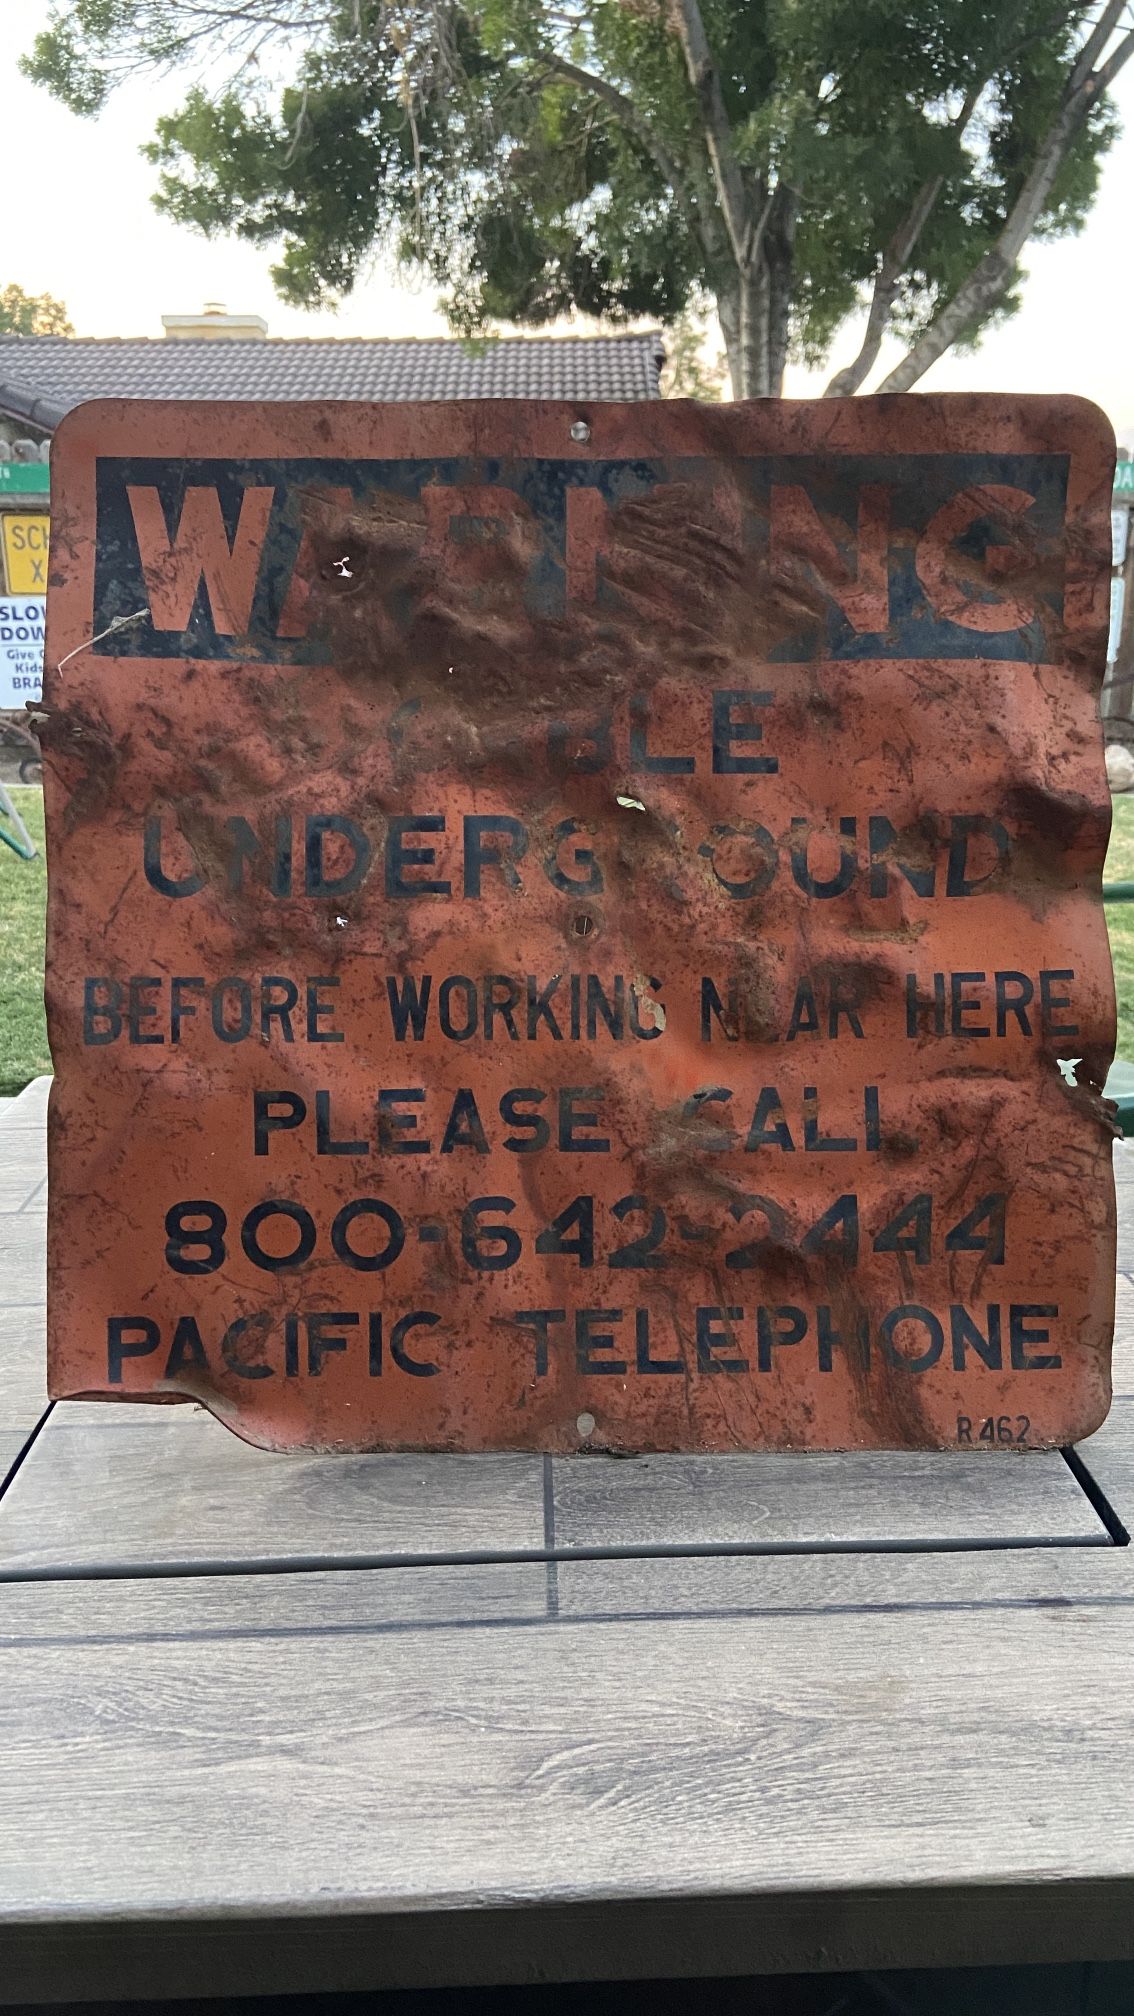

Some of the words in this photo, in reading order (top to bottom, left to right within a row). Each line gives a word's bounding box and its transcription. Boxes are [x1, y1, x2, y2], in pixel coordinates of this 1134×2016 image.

[7, 648, 35, 660] Give
[143, 814, 1010, 900] UNDERGOUND
[82, 976, 345, 1046] BEFORE
[387, 974, 667, 1042] WORKING
[701, 975, 865, 1042] NAR
[905, 969, 1080, 1039] HERE
[253, 1086, 611, 1156] PLEASE
[164, 1193, 1006, 1275] 800-642-2444
[107, 1310, 443, 1385] PACIFIC
[517, 1304, 1062, 1376] TELEPHONE
[957, 1415, 973, 1444] R
[979, 1415, 1031, 1444] 462
